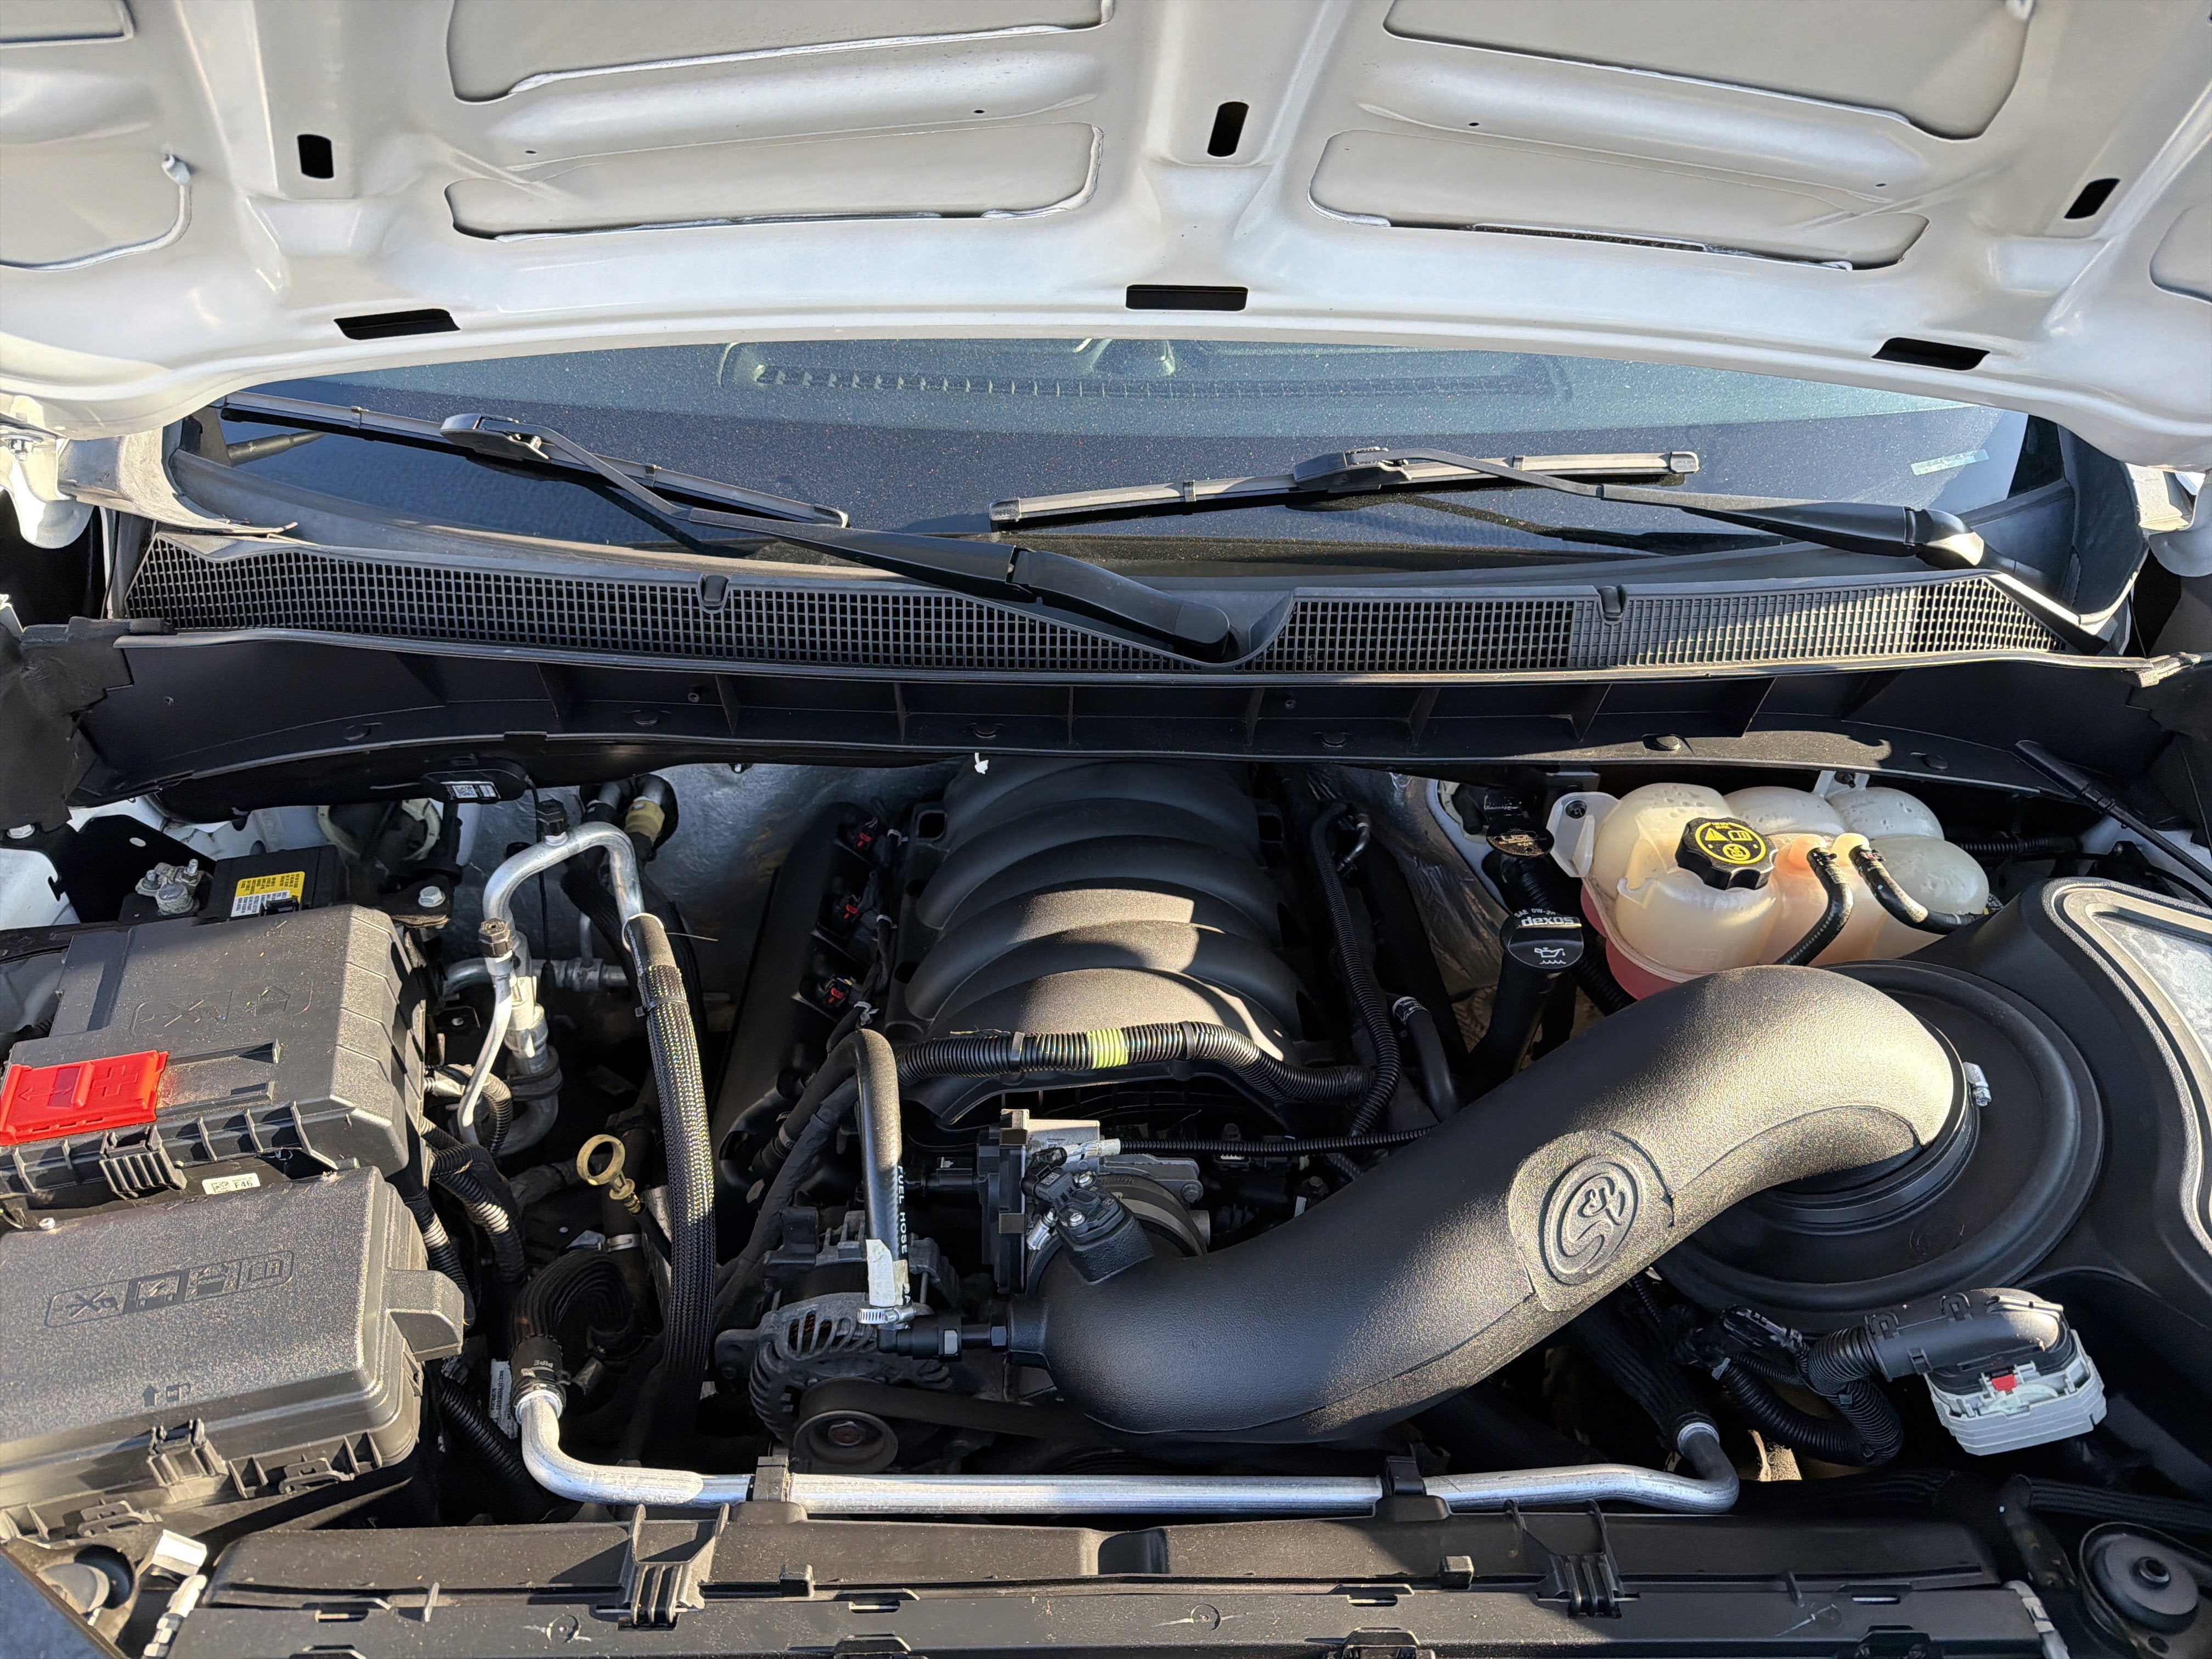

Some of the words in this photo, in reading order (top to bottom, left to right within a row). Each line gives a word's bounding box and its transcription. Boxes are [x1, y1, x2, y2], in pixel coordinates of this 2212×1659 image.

[1514, 909, 1529, 918] SAE
[1521, 916, 1575, 927] dexos
[234, 1180, 253, 1189] F46
[900, 1212, 908, 1255] HOSE
[533, 1359, 554, 1368] PIPE
